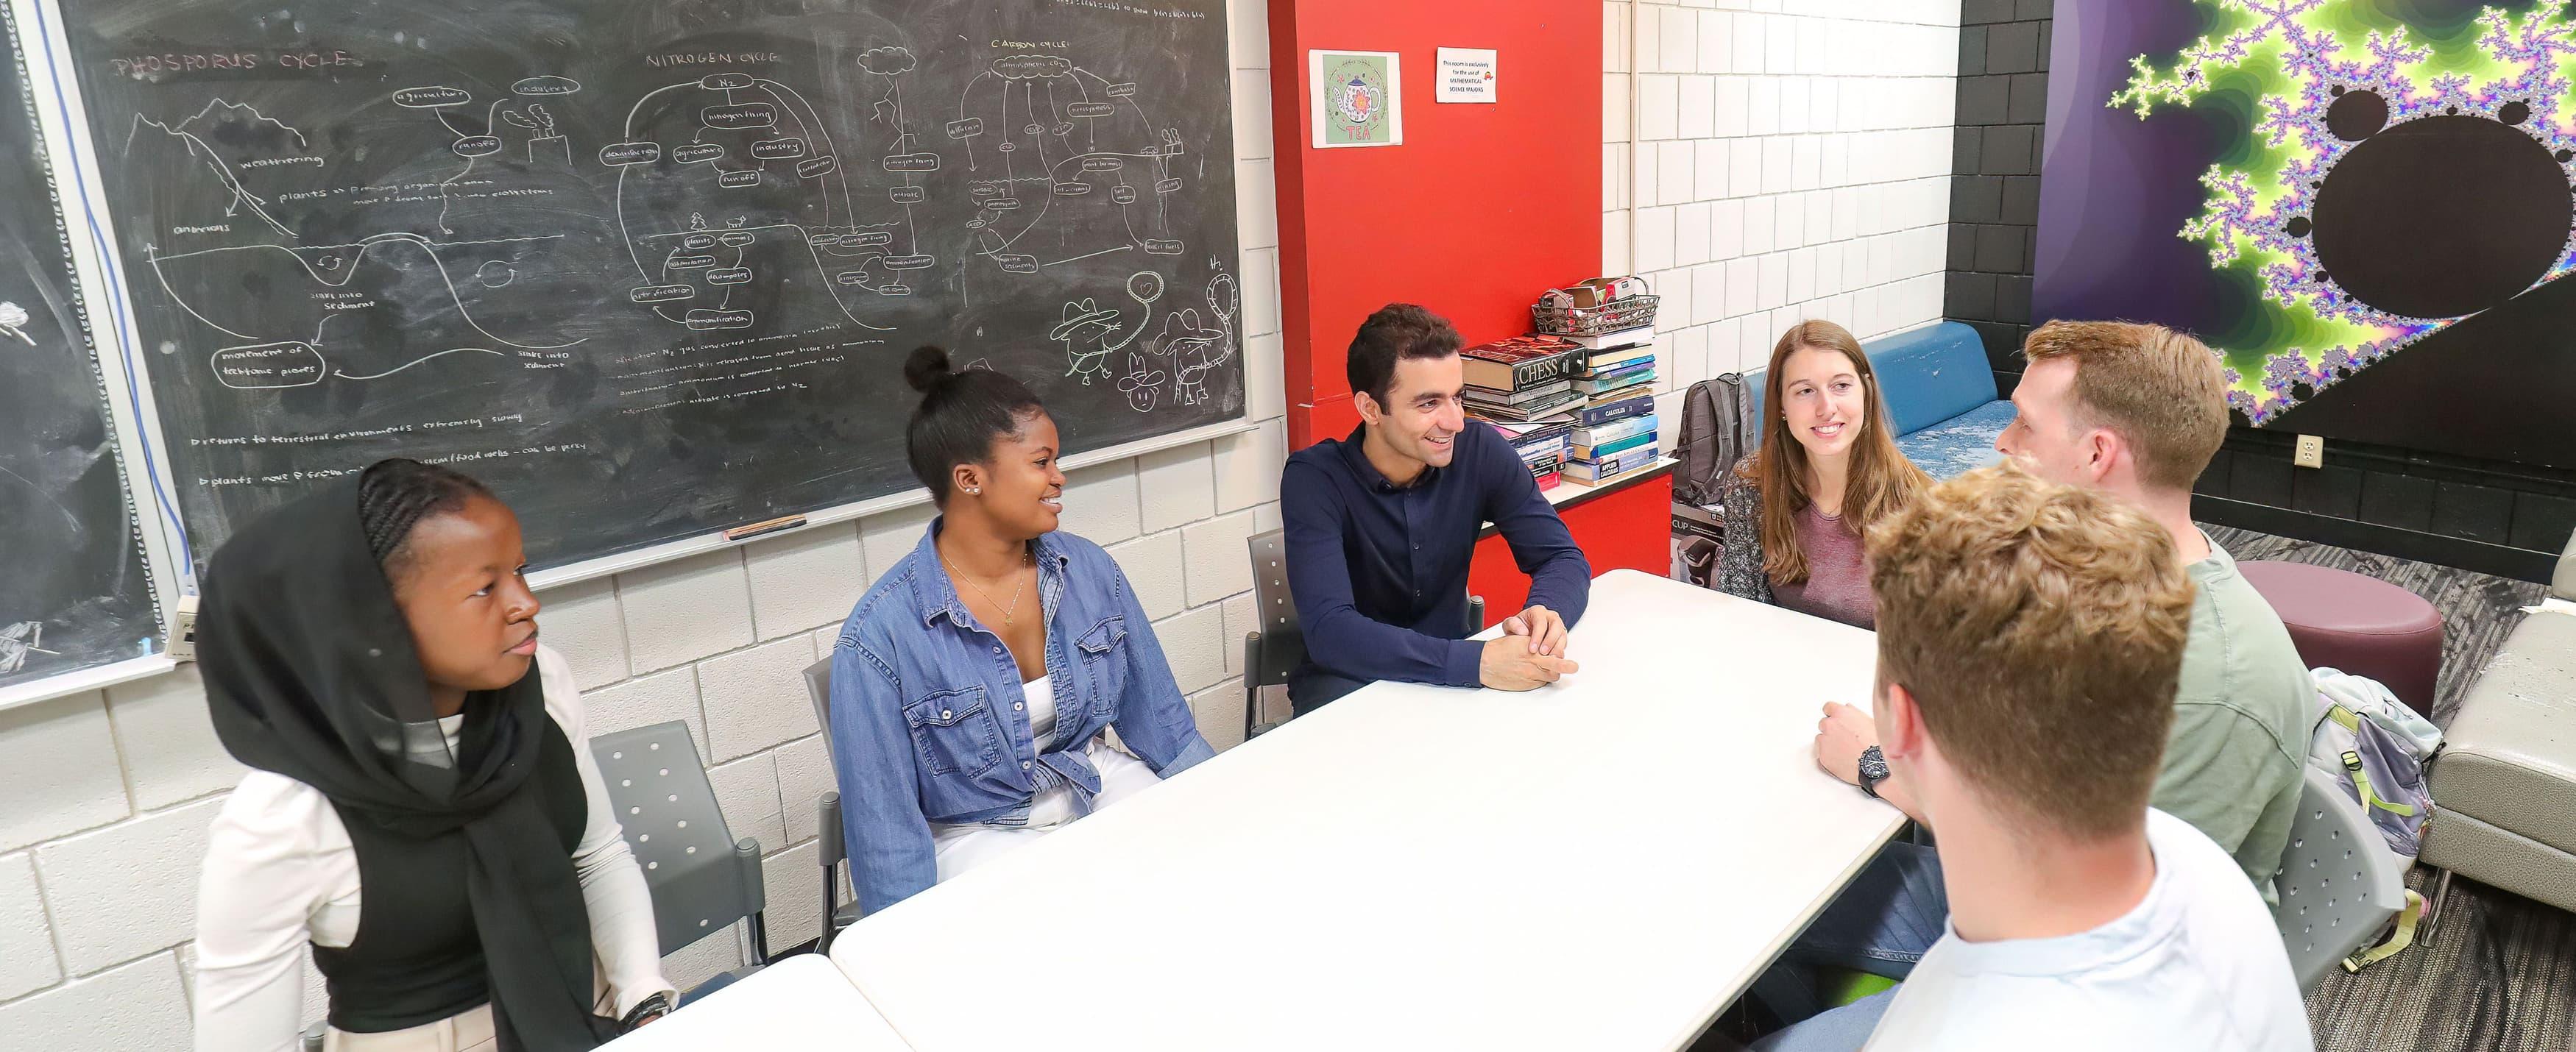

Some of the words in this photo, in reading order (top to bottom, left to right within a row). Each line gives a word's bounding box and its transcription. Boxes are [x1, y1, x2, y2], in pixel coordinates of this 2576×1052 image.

[991, 40, 1036, 50] CARBON
[645, 51, 732, 68] NITROGEN
[739, 51, 780, 65] CYCLE
[1345, 125, 1371, 141] TEA
[277, 189, 328, 205] plants
[1518, 358, 1559, 385] CHESS
[1605, 407, 1626, 417] CALCULUS
[252, 435, 267, 444] to
[1602, 461, 1617, 472] APPLIED
[1600, 468, 1618, 478] CALCULUS
[1672, 519, 1689, 530] CUP
